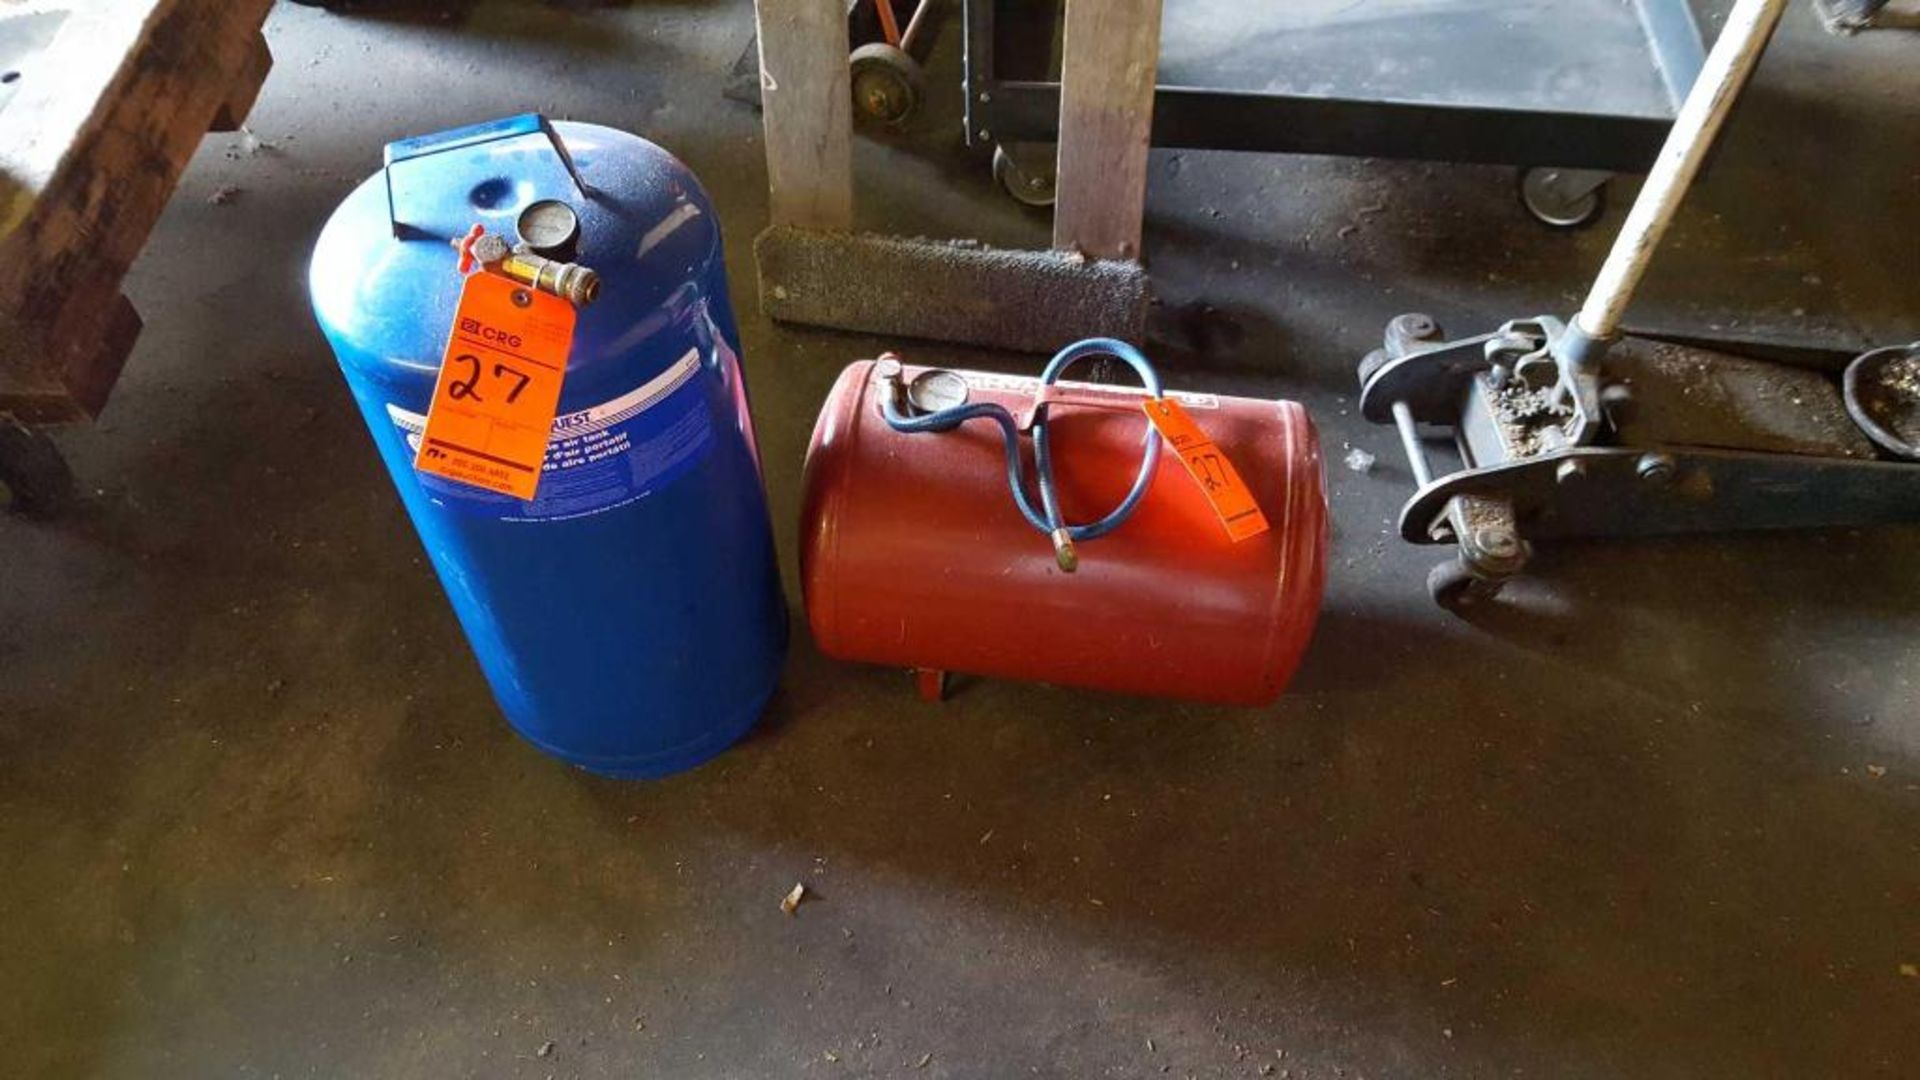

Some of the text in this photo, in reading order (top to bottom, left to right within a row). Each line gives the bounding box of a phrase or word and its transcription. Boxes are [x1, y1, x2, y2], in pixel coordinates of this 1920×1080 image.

[483, 327, 522, 348] CRG
[450, 355, 531, 404] 27
[552, 412, 591, 432] UEST
[563, 438, 579, 449] air
[583, 430, 610, 443] tank
[584, 432, 628, 454] portatif
[542, 461, 558, 472] de
[562, 457, 586, 468] aire
[1192, 454, 1230, 491] 27
